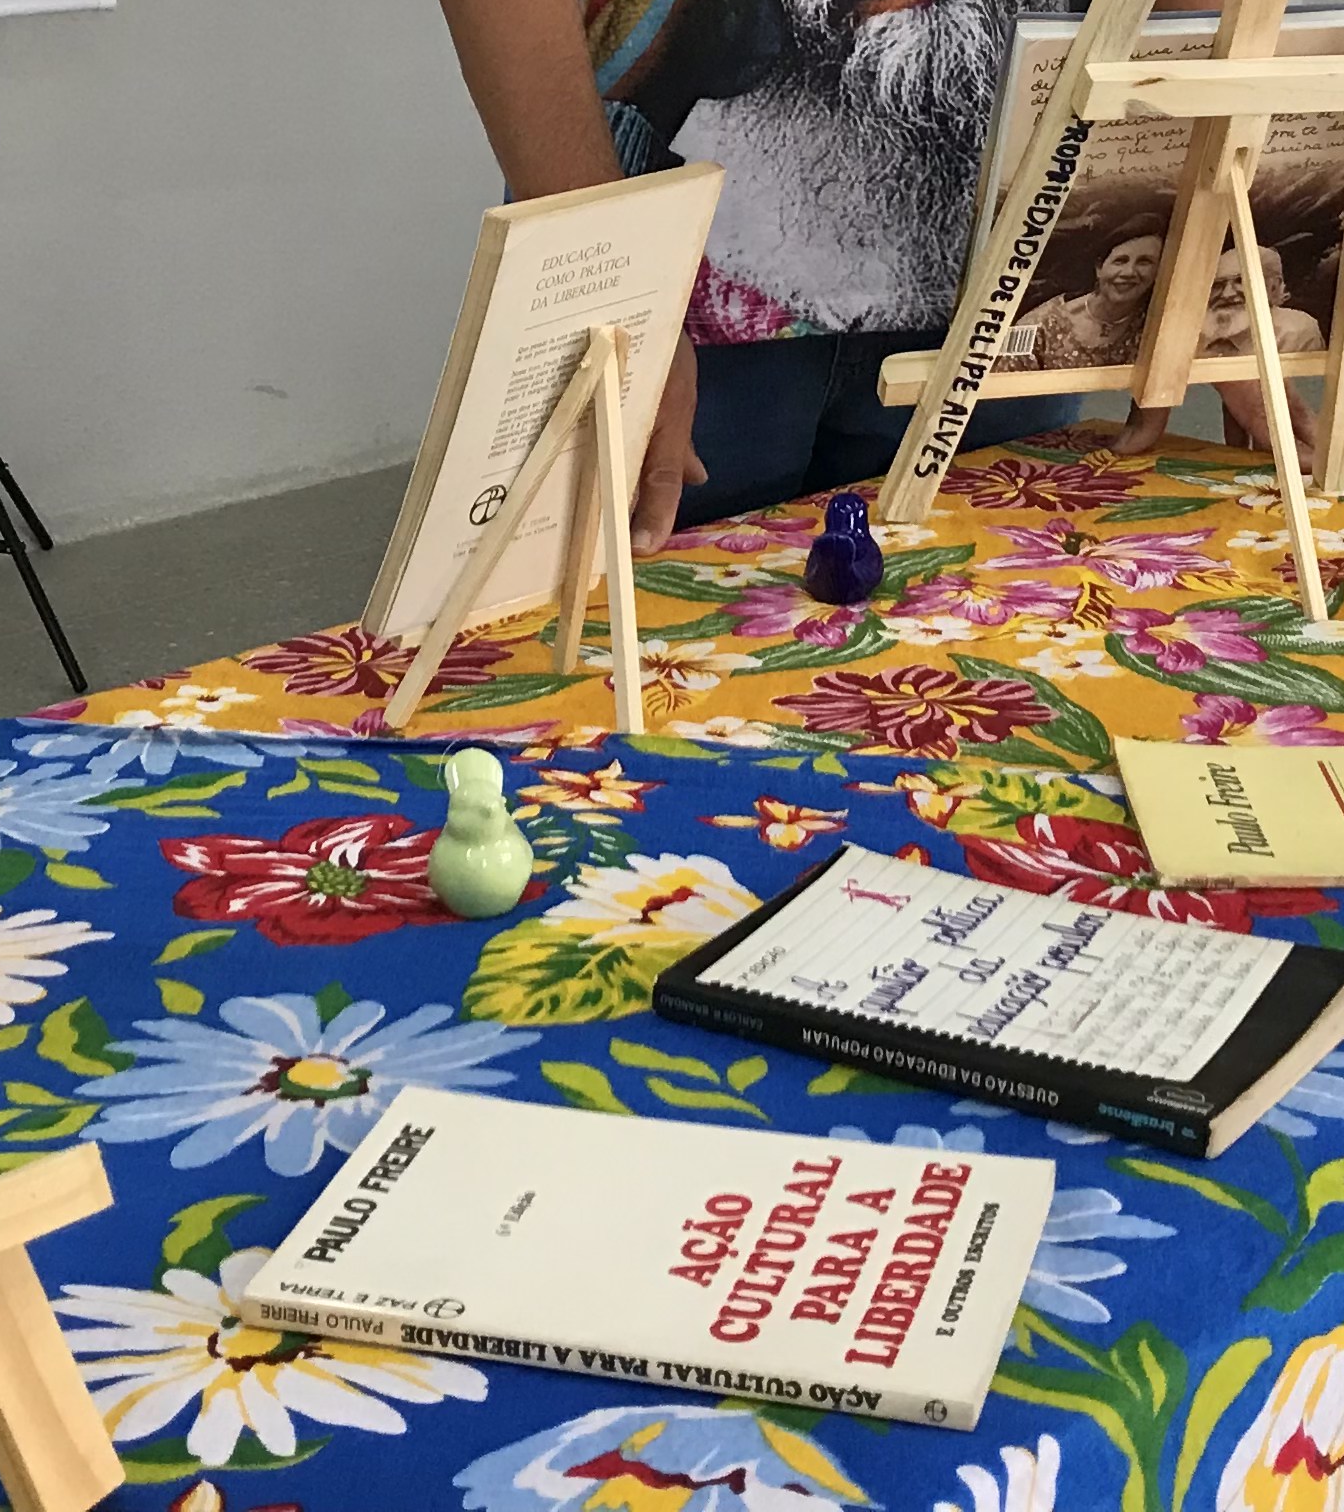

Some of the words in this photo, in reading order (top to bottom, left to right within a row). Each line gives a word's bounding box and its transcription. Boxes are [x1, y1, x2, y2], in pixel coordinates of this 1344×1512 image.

[535, 270, 576, 292] COMO
[579, 255, 631, 279] PRÁTICA
[542, 241, 612, 272] EDUCAÇÃO
[529, 295, 548, 312] DA
[553, 275, 621, 305] LIBERDADE
[989, 275, 1021, 303] DE
[913, 399, 968, 479] ALVES
[1199, 762, 1252, 810] Freire
[1216, 811, 1274, 857] Paulo
[859, 959, 930, 1017] questão
[922, 894, 1004, 951] política
[937, 947, 1006, 985] da
[960, 964, 1051, 1039] educação
[1037, 905, 1113, 975] popular
[798, 1026, 873, 1056] POPULAR
[870, 1044, 959, 1079] EDUCAÇÃO
[955, 1064, 983, 1085] DA
[980, 1072, 1064, 1105] QUESTÃO
[1095, 1102, 1176, 1136] brasiliense
[304, 1198, 377, 1263] PAULO
[360, 1125, 434, 1192] FREIRE
[503, 1191, 536, 1222] Edição
[670, 1194, 752, 1286] AÇÃO
[711, 1158, 840, 1343] CULTURAL
[964, 1203, 1000, 1262] ESCRITOS
[791, 1229, 877, 1323] PARA
[846, 1188, 896, 1214] A
[846, 1161, 973, 1368] LIBERDADE
[277, 1281, 345, 1301] TERRA
[352, 1292, 369, 1304] E
[373, 1294, 418, 1310] PAZ
[941, 1268, 976, 1322] OUTROS
[257, 1301, 322, 1330] FREIRE
[324, 1311, 386, 1339] PAULO
[935, 1327, 955, 1337] E
[396, 1321, 548, 1362] LIBERDADE
[550, 1344, 573, 1365] A
[576, 1348, 650, 1376] PARA
[654, 1359, 804, 1399] CULTURAL
[806, 1377, 883, 1414] AÇÃO
